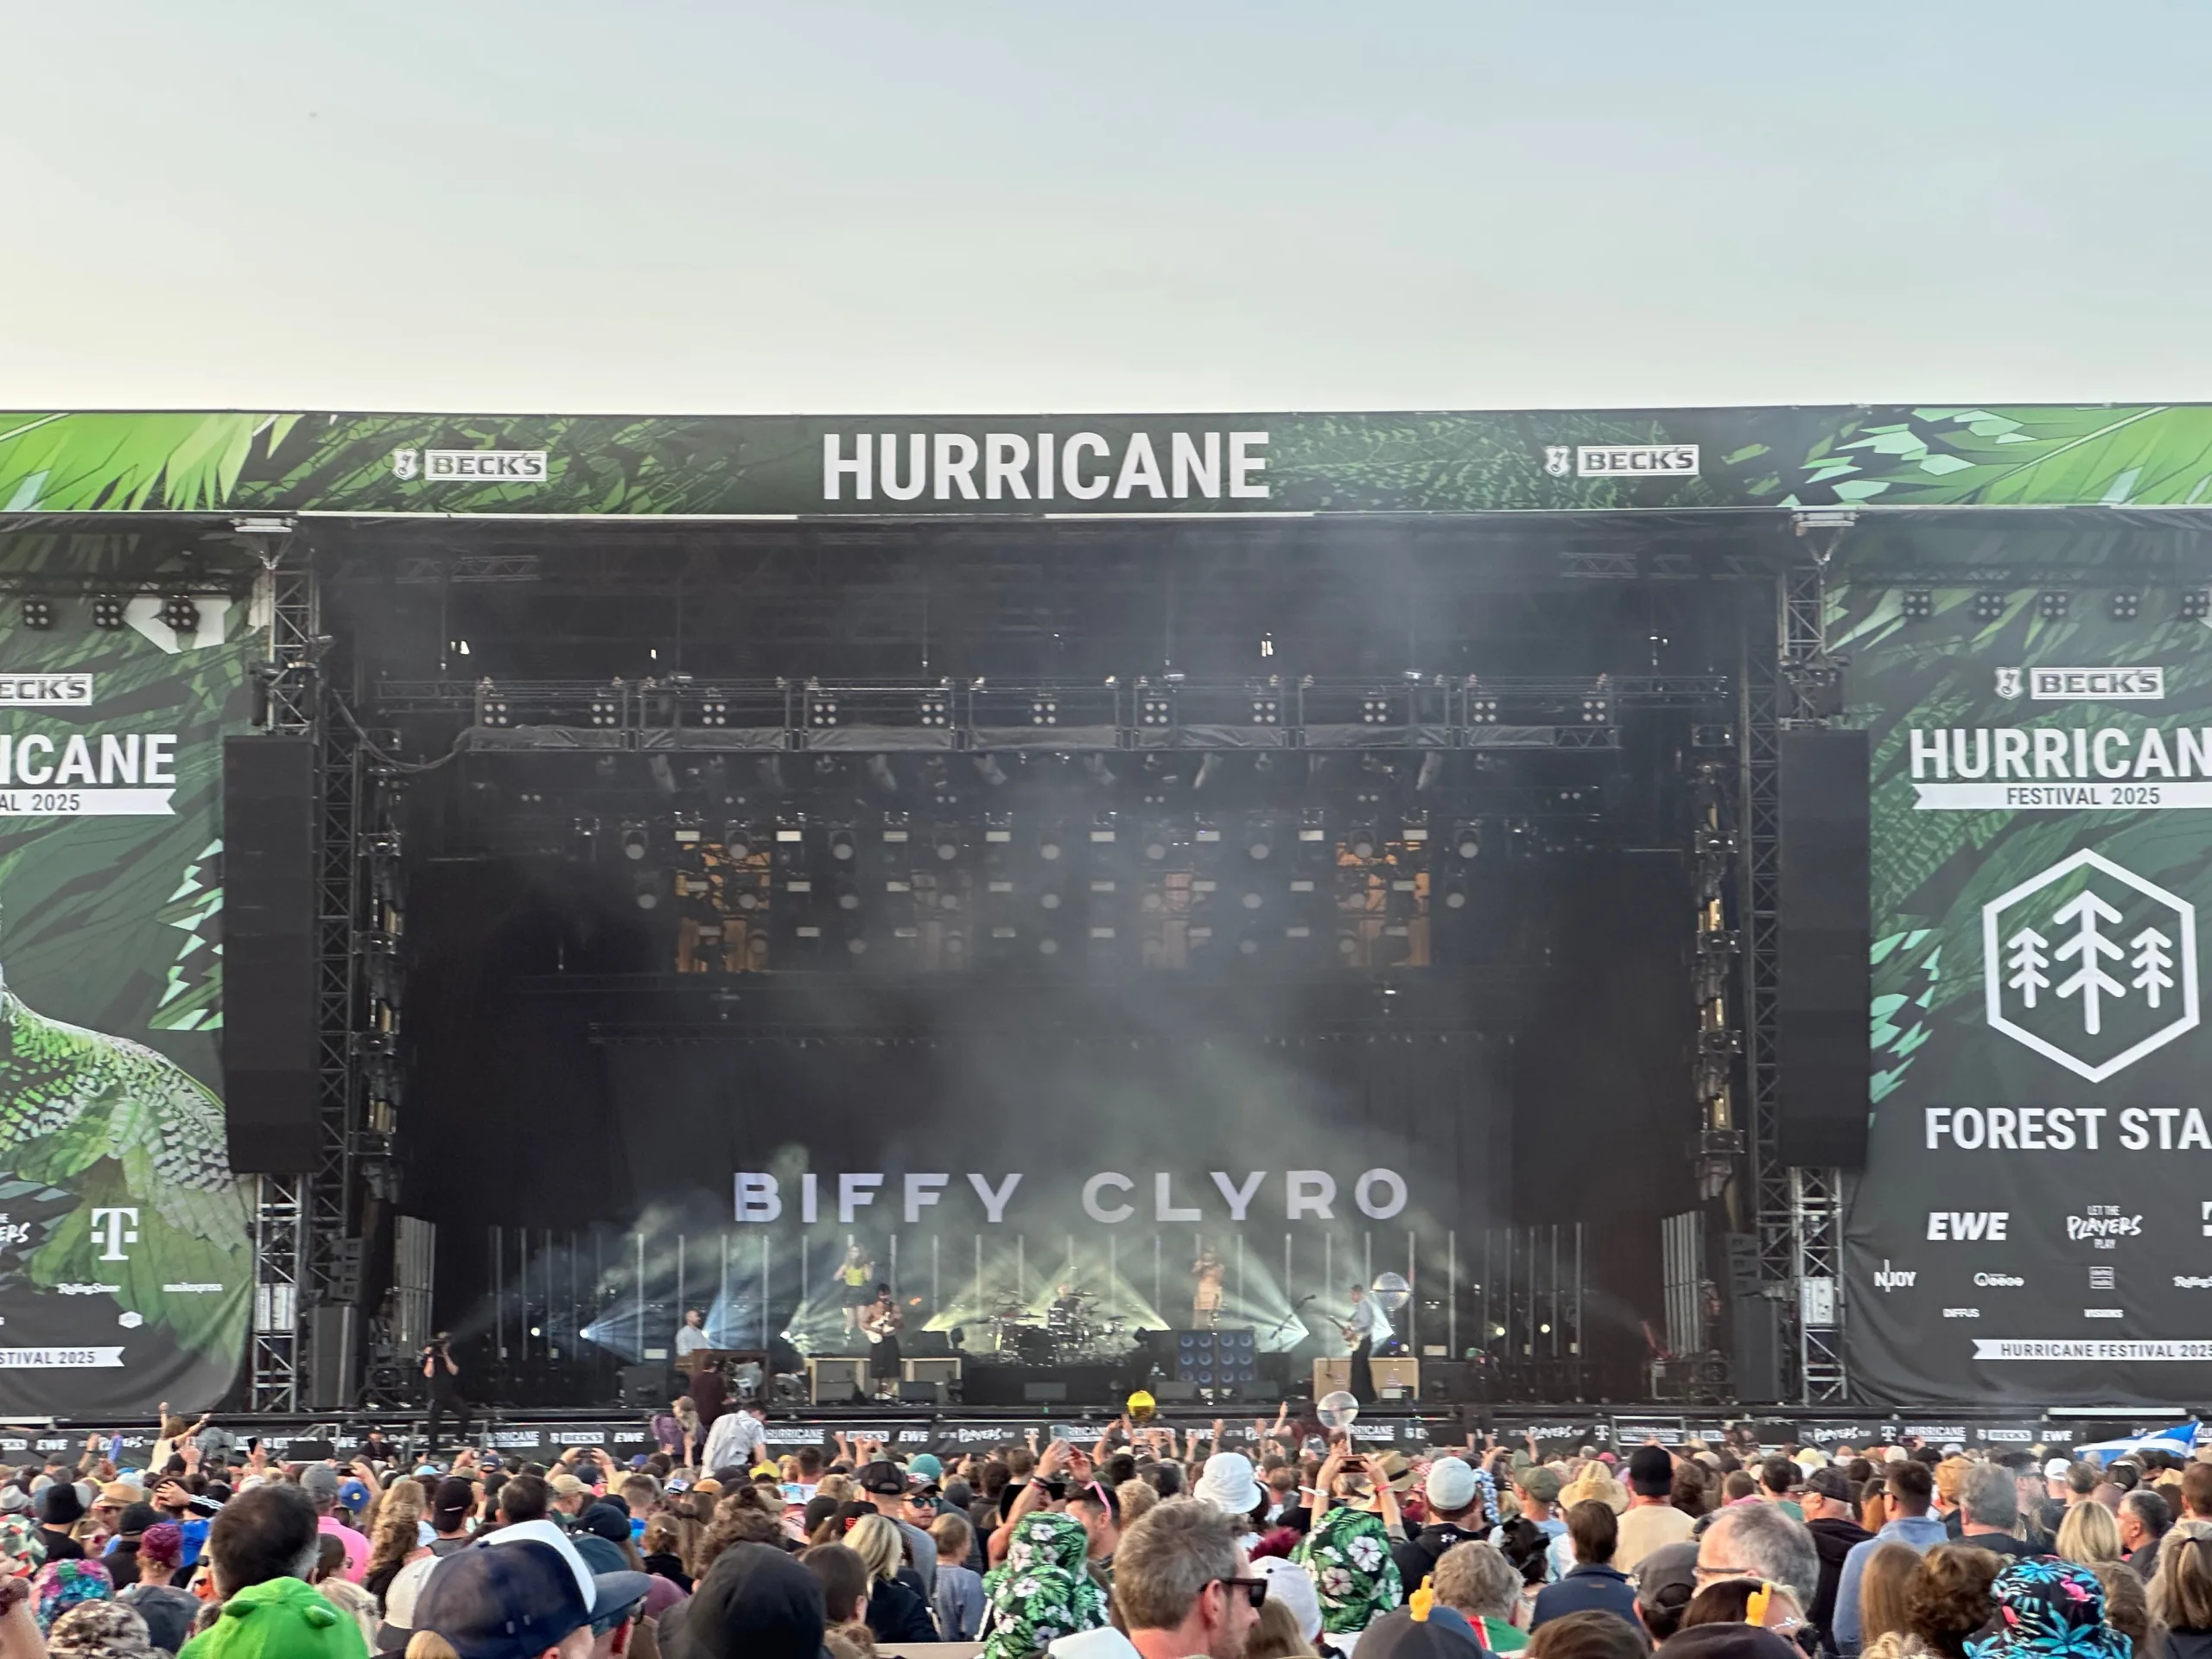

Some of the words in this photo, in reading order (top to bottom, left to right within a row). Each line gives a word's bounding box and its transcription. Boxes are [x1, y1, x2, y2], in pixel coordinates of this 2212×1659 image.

[432, 453, 542, 475] BECK'S
[823, 431, 1270, 500] HURRICANE
[1585, 448, 1694, 470] BECK'S
[2038, 670, 2158, 693] BECK'S
[1910, 728, 2212, 779] HURRICAN
[32, 794, 80, 811] 2025
[2007, 787, 2101, 805] FESTIVAL
[2111, 786, 2160, 804] 2025
[1925, 1107, 2107, 1150] FOREST
[2119, 1107, 2212, 1150] STA
[734, 1173, 1022, 1223] BIFFY
[1082, 1168, 1408, 1223] CLYRO
[1927, 1211, 2009, 1241] EWE
[2067, 1214, 2143, 1241] PLAYERS
[59, 1351, 96, 1364] 2025
[2001, 1344, 2093, 1357] HURRICANE
[2099, 1344, 2175, 1357] FESTIVAL
[614, 1433, 645, 1442] EWE
[899, 1432, 929, 1442] EWE
[2042, 1431, 2073, 1441] EWE
